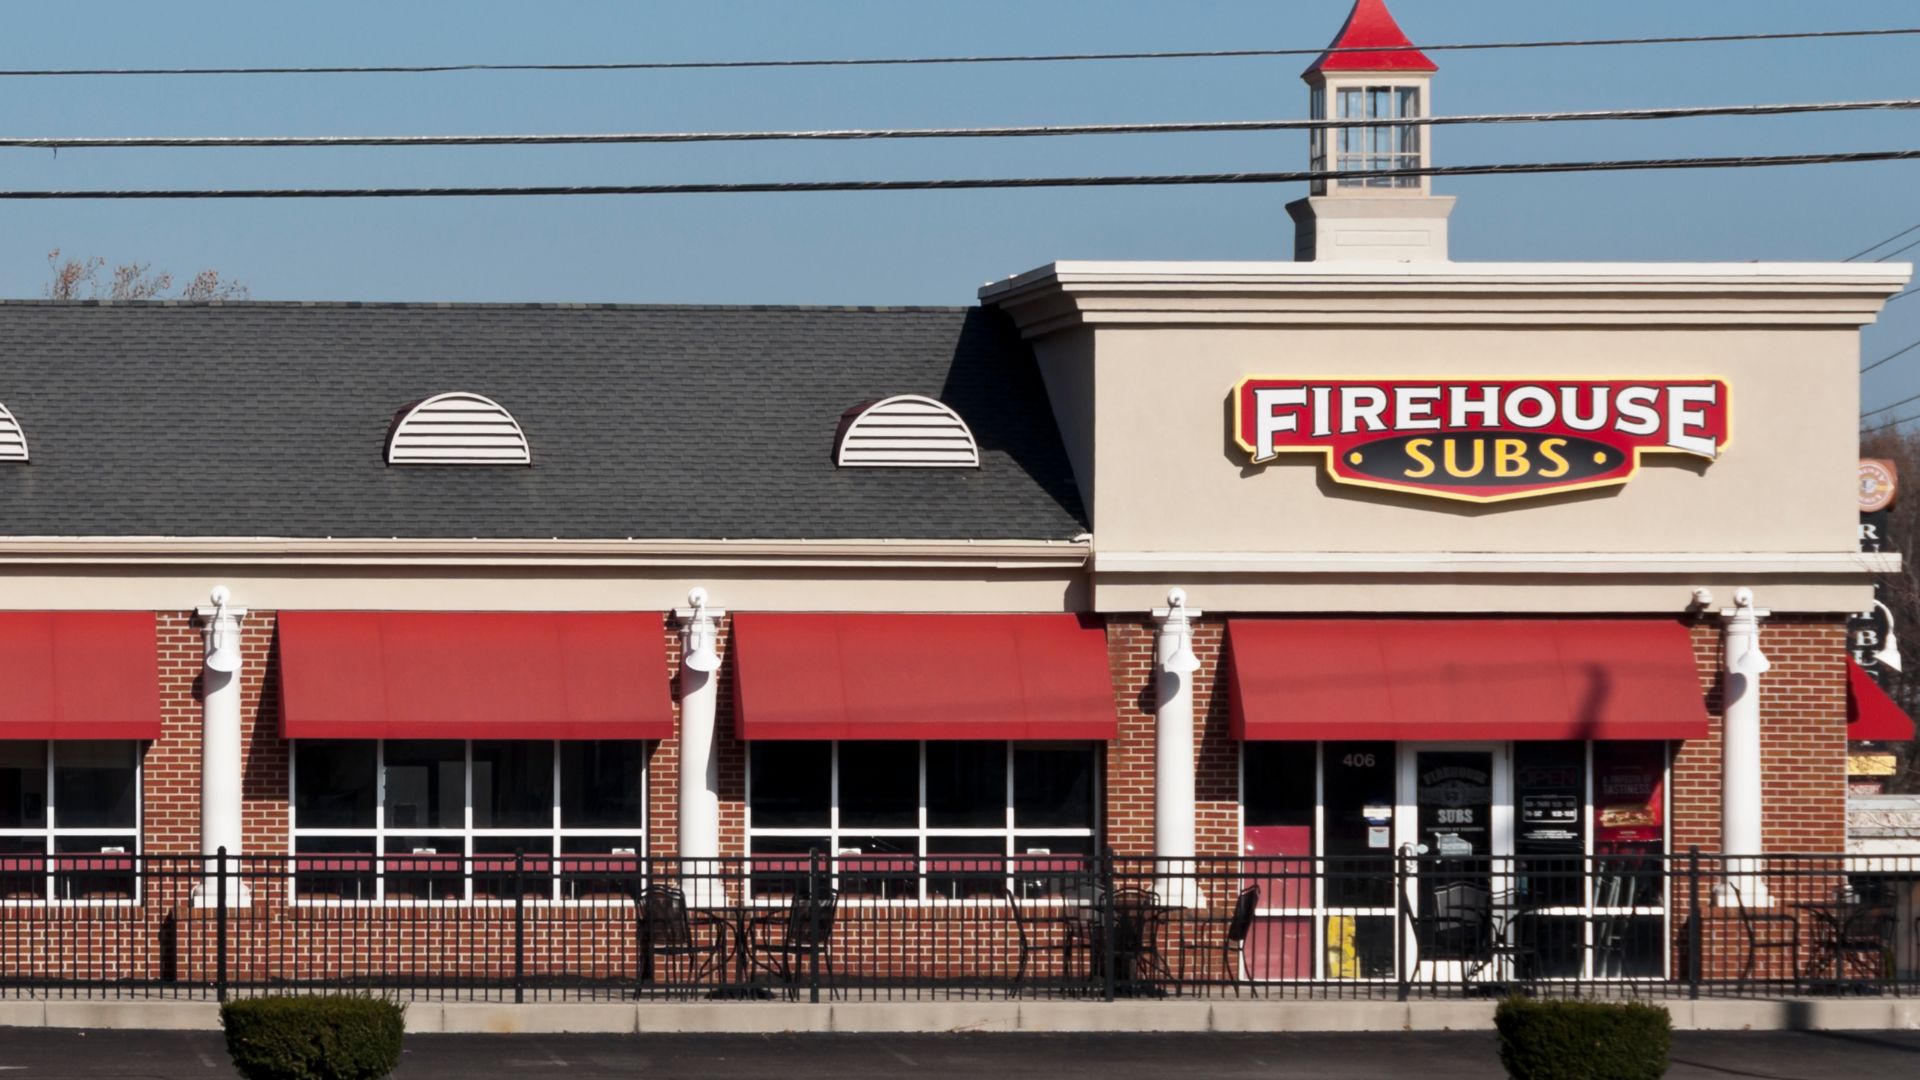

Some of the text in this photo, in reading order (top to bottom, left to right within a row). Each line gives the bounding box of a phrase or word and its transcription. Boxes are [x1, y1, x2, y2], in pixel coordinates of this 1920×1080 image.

[1253, 384, 1717, 460] FIREHOUSE
[1404, 438, 1570, 478] SUBS
[1343, 753, 1376, 768] 406
[1437, 808, 1473, 824] SUBS
